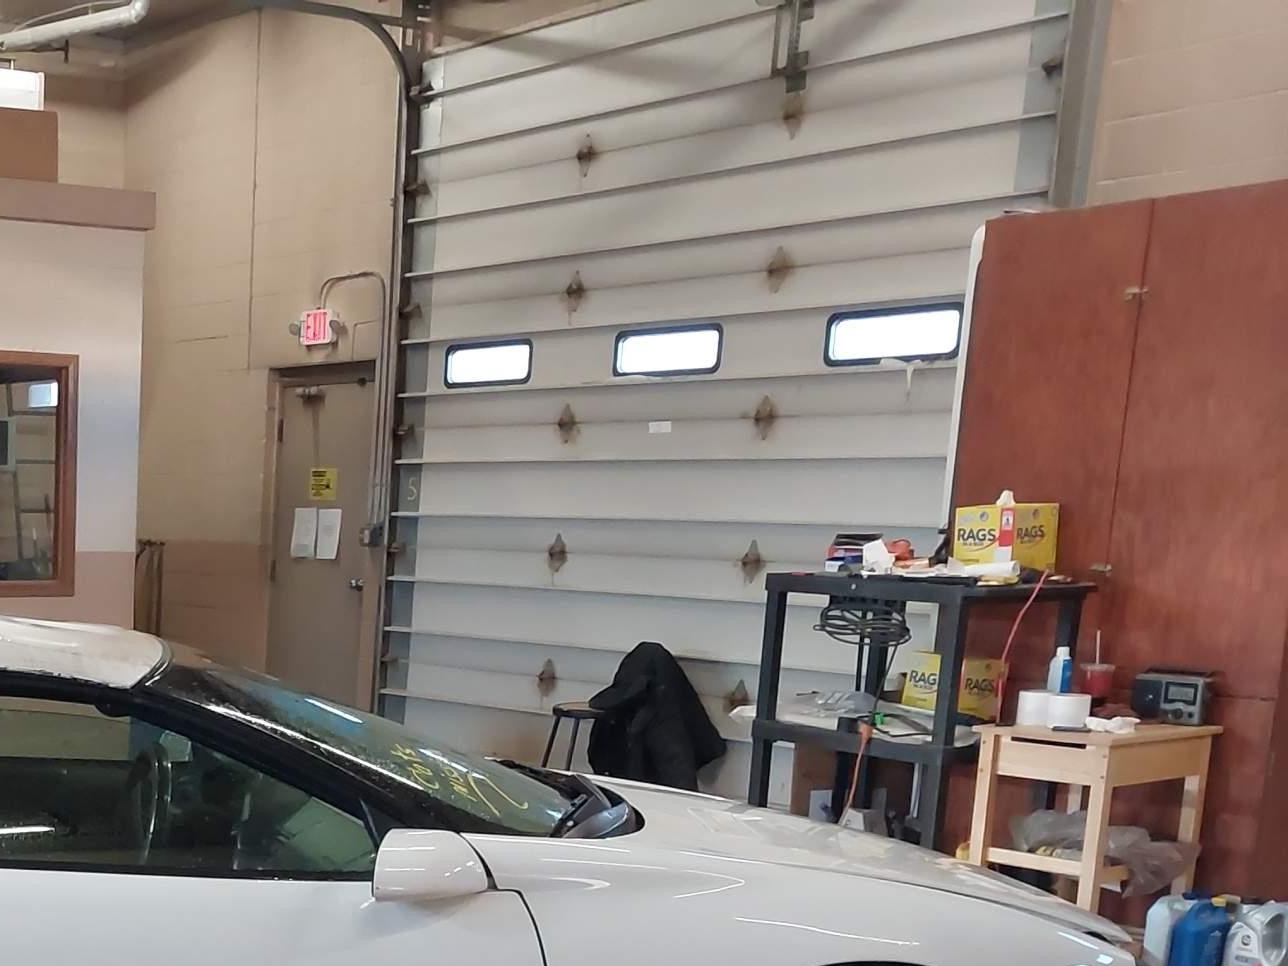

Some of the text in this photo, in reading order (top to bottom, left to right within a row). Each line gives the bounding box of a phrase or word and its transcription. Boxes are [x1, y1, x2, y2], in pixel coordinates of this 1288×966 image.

[957, 528, 996, 542] RAGS
[1016, 525, 1045, 541] RAGS
[909, 669, 938, 686] RAG
